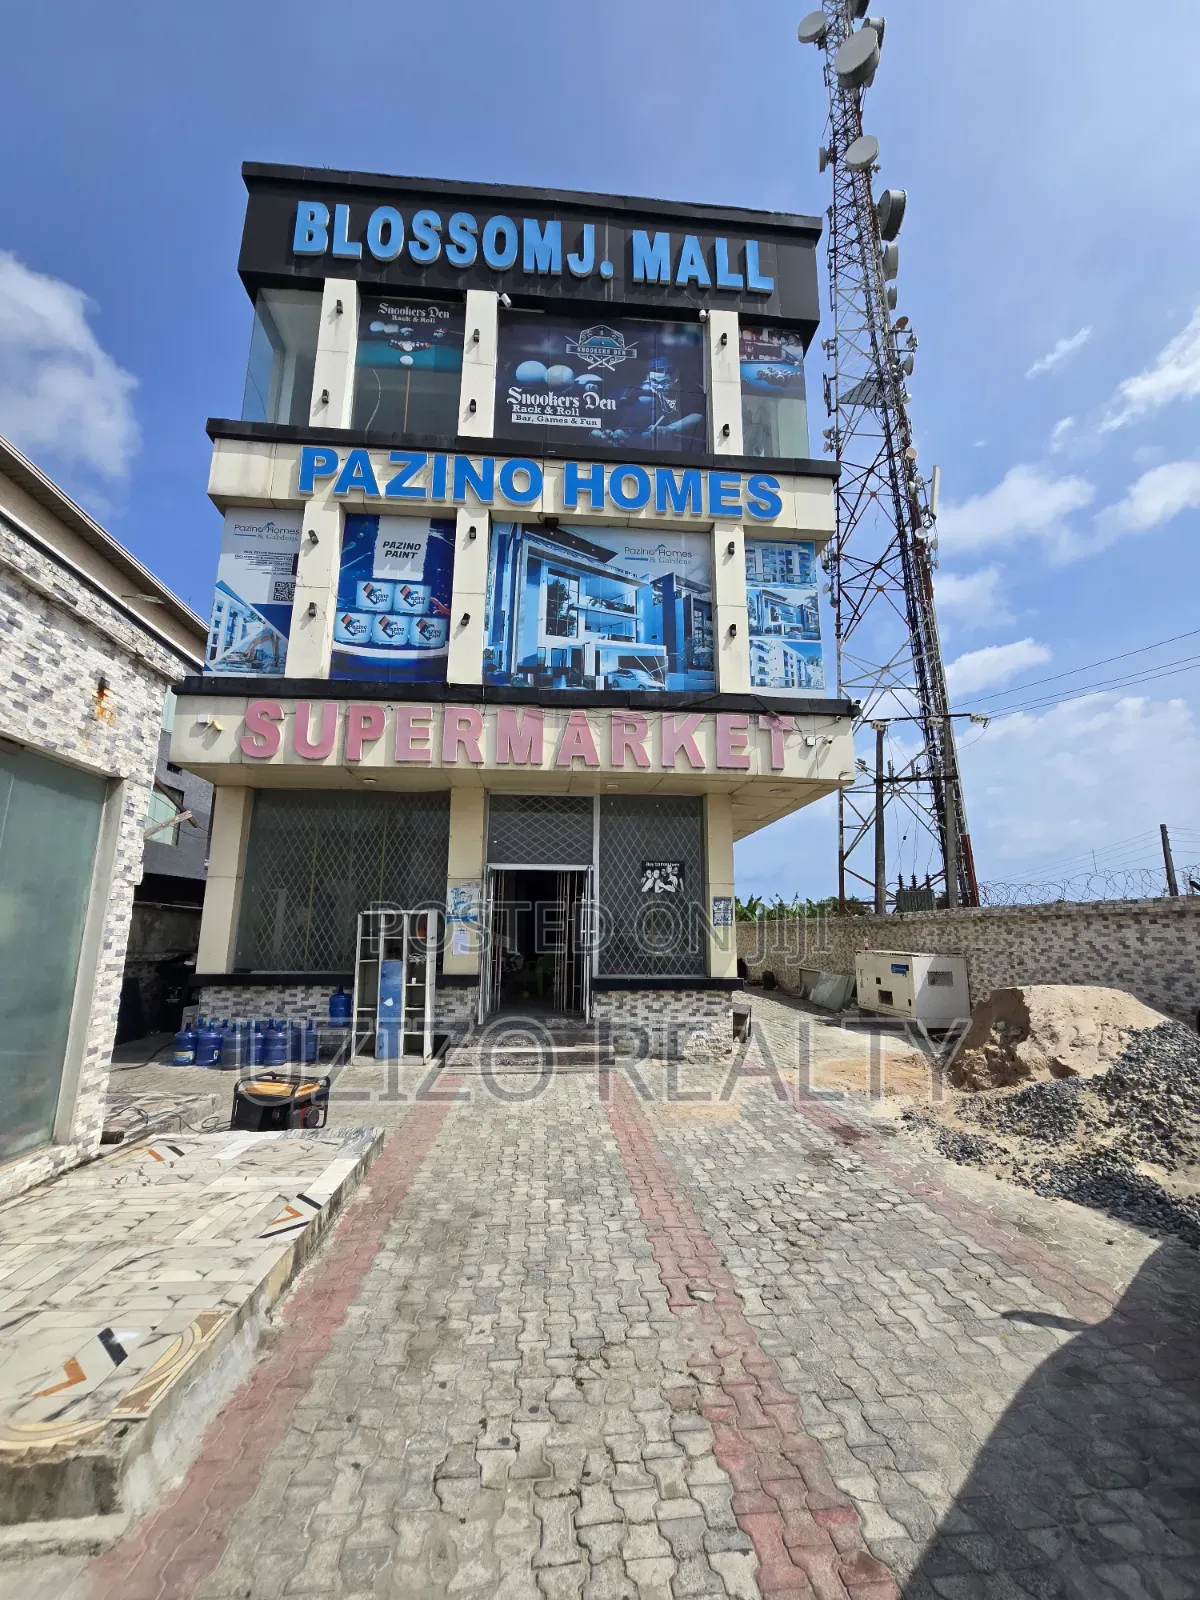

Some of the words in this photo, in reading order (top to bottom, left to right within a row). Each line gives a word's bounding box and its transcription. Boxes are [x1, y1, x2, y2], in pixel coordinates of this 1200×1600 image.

[631, 230, 774, 294] MALL
[378, 303, 427, 317] Snookers
[428, 306, 450, 319] Den
[507, 386, 580, 407] Snookers
[583, 391, 617, 411] Den
[512, 404, 542, 414] Rack
[544, 406, 554, 415] &
[556, 407, 580, 417] Roll
[516, 414, 534, 423] Bar,
[537, 415, 569, 424] Games
[570, 417, 579, 425] &
[580, 418, 598, 426] Fun
[298, 446, 544, 505] PAZINO
[563, 461, 783, 521] HOMES
[234, 524, 264, 533] Pazino
[266, 526, 300, 536] Homes
[382, 541, 422, 551] PAZINO
[624, 546, 655, 556] Pazino
[658, 547, 693, 558] Homes
[385, 550, 418, 559] PAINT
[658, 556, 692, 565] Gardens
[240, 700, 795, 770] SUPERMARKET
